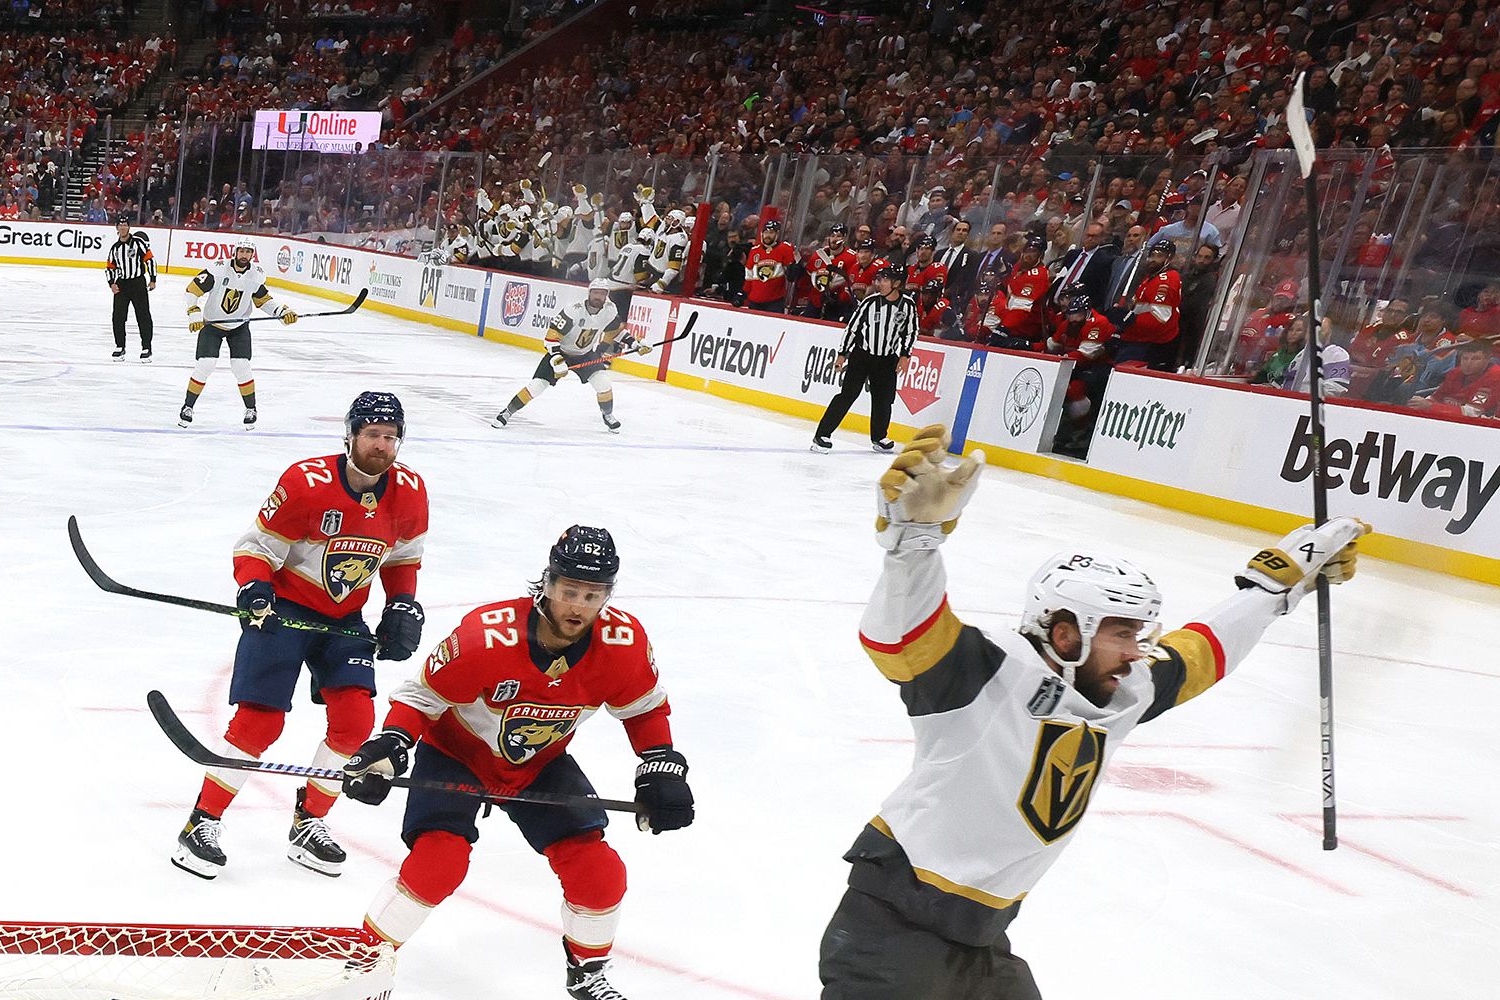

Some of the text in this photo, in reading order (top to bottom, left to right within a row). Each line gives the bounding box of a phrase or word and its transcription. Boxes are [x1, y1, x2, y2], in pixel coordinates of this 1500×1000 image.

[308, 113, 357, 136] Online
[57, 229, 102, 254] Clips
[184, 242, 260, 263] HONA
[311, 253, 353, 286] DISCOVER
[420, 266, 443, 309] CAT
[536, 290, 557, 309] a sub
[689, 326, 770, 379] verizon
[905, 355, 939, 393] Rate
[1100, 399, 1187, 452] meister
[297, 458, 333, 488] 22
[1280, 414, 1500, 536] betway
[333, 540, 383, 556] PANTHERS
[584, 542, 602, 557] 62
[390, 600, 424, 621] CM
[479, 606, 520, 650] 62
[347, 657, 375, 669] CC
[511, 706, 579, 721] PANTHERS
[636, 760, 687, 778] ARRIOR
